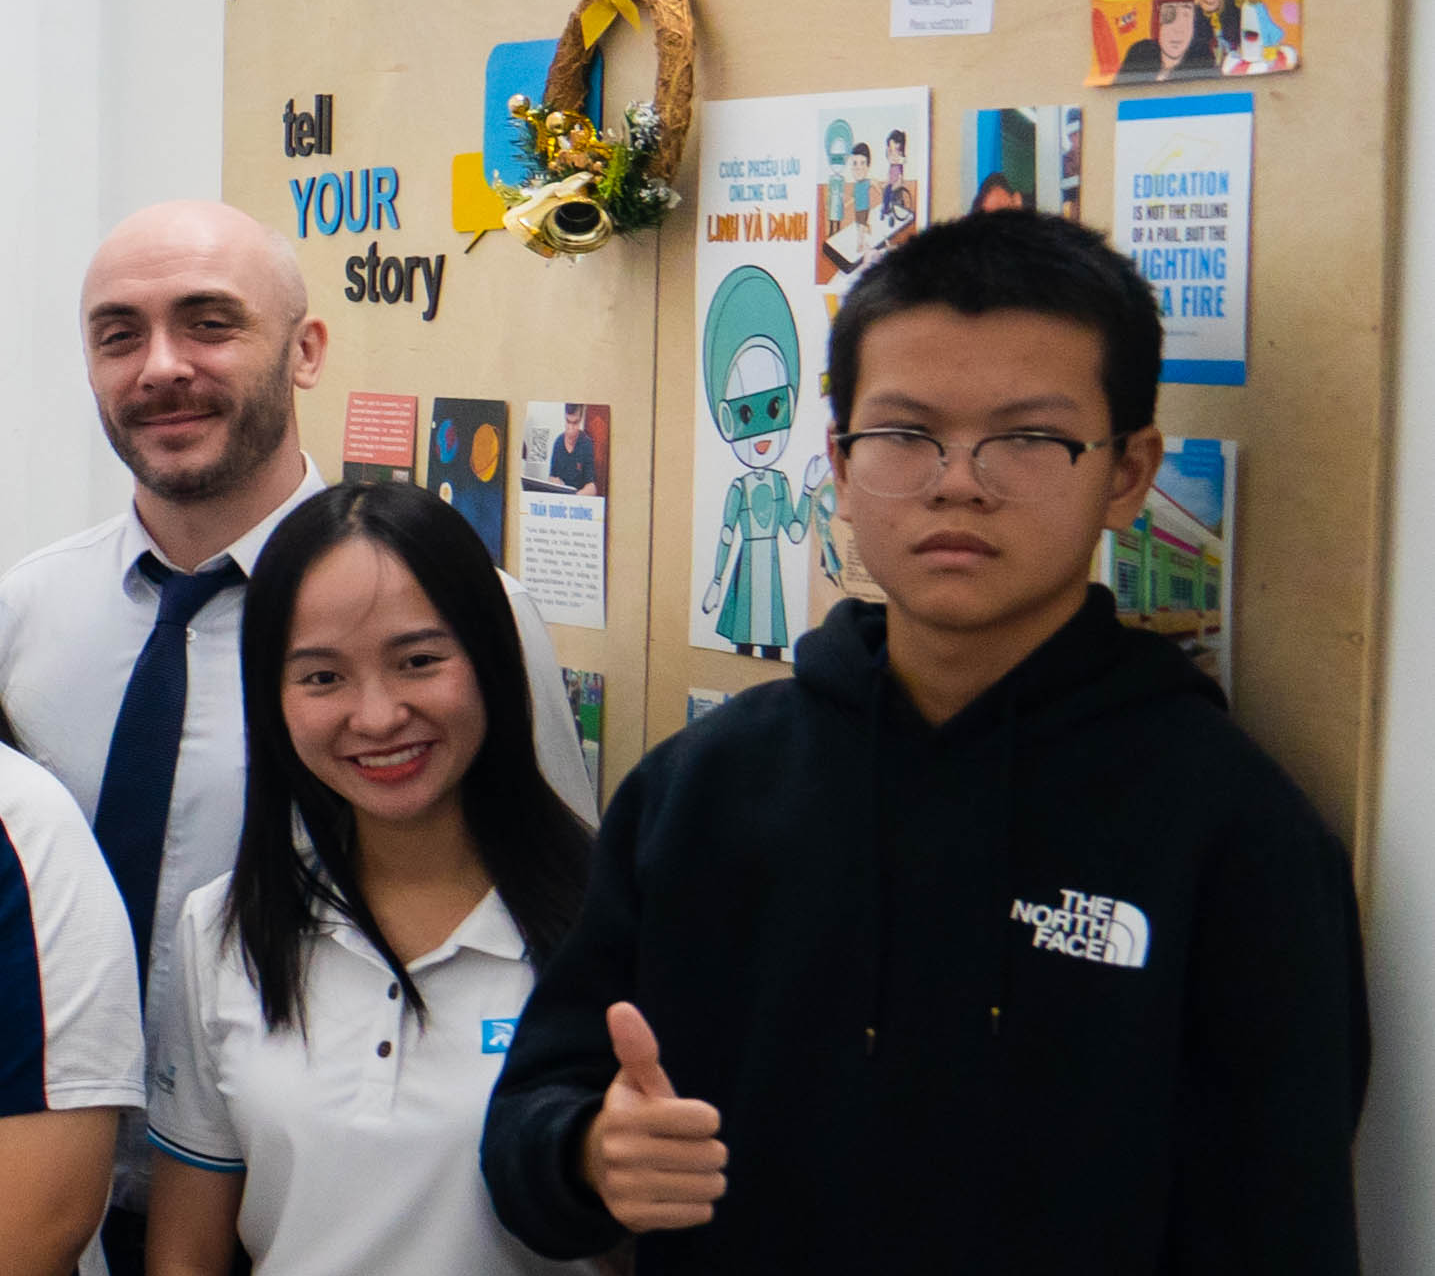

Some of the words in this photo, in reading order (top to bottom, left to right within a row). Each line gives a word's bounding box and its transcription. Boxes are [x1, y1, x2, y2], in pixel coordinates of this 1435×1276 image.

[283, 94, 333, 158] tell
[1133, 171, 1229, 199] EDUCATION
[289, 166, 400, 238] YOUR
[1133, 205, 1143, 221] IS
[1146, 205, 1165, 221] NOT
[1168, 204, 1187, 220] THE
[1190, 202, 1228, 219] FILLING
[707, 212, 740, 242] LINH
[767, 211, 808, 242] DANH
[1132, 227, 1144, 243] OF
[1147, 227, 1154, 242] A
[1185, 226, 1205, 242] BUT
[1209, 225, 1227, 241] THE
[344, 241, 446, 321] story
[1162, 286, 1174, 317] A
[1181, 285, 1226, 318] FIRE
[1059, 888, 1114, 919] THE
[1010, 899, 1109, 949] NORTH
[1032, 927, 1105, 962] FACE
